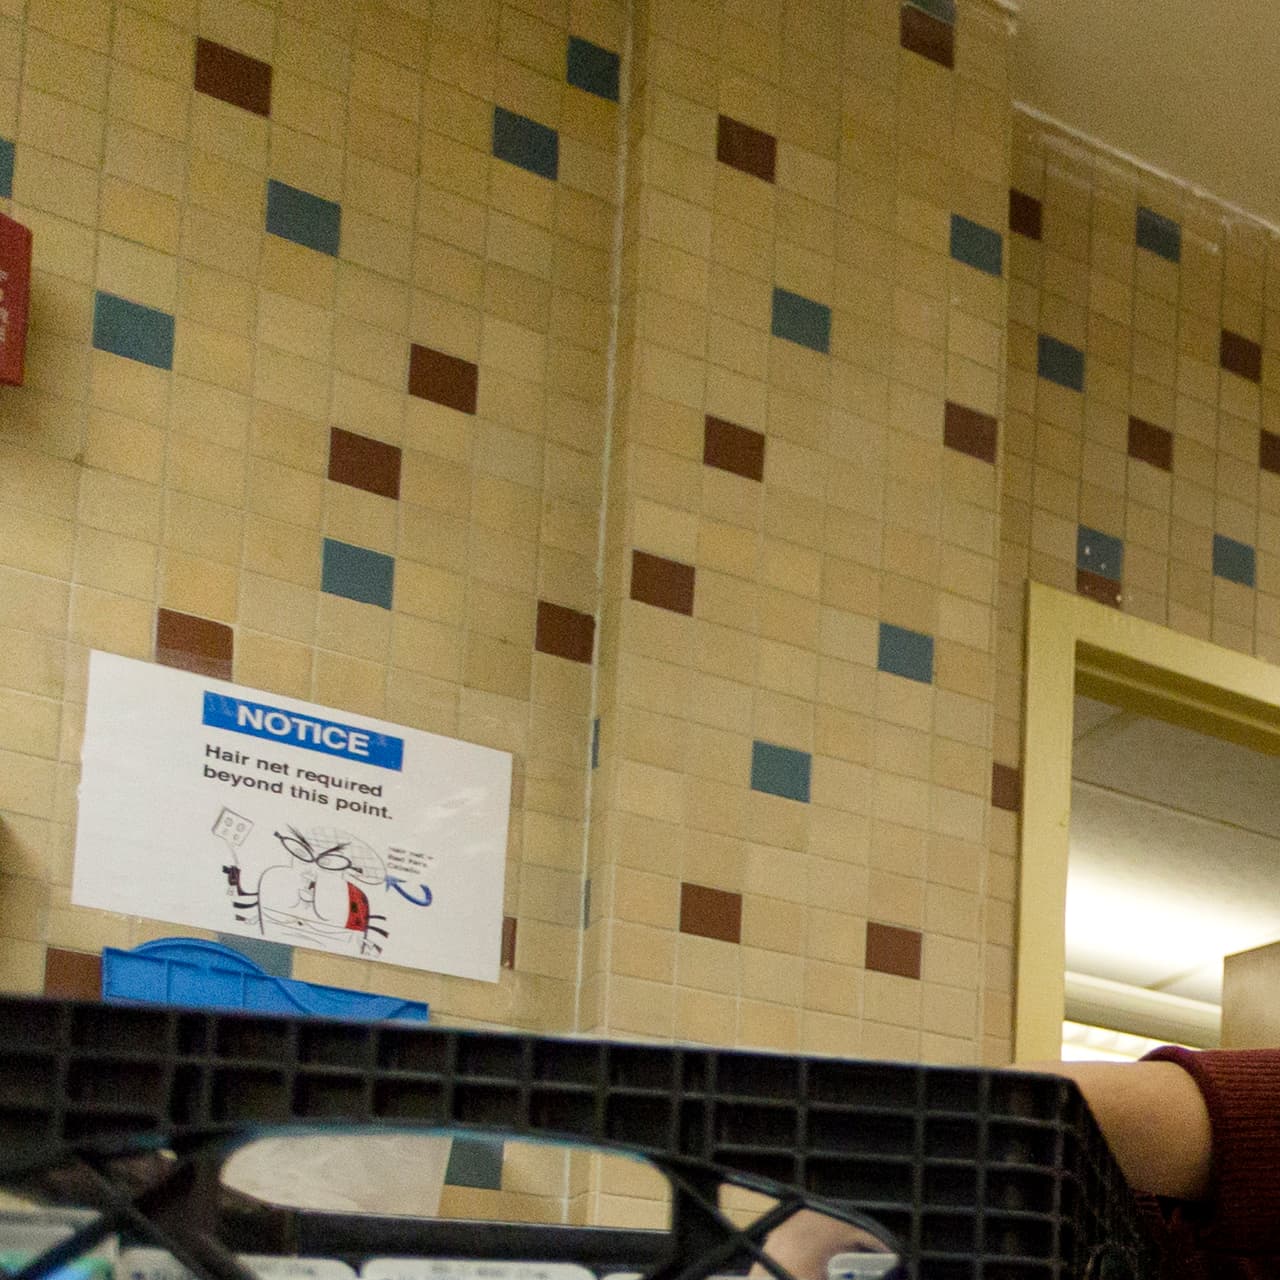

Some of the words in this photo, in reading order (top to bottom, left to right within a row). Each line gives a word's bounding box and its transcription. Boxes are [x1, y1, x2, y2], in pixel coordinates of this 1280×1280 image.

[236, 704, 370, 756] NOTICE
[203, 765, 283, 794] beyond
[291, 785, 329, 805] this
[336, 797, 393, 820] point.
[204, 744, 250, 766] Hair
[256, 757, 289, 776] net
[296, 768, 383, 797] required
